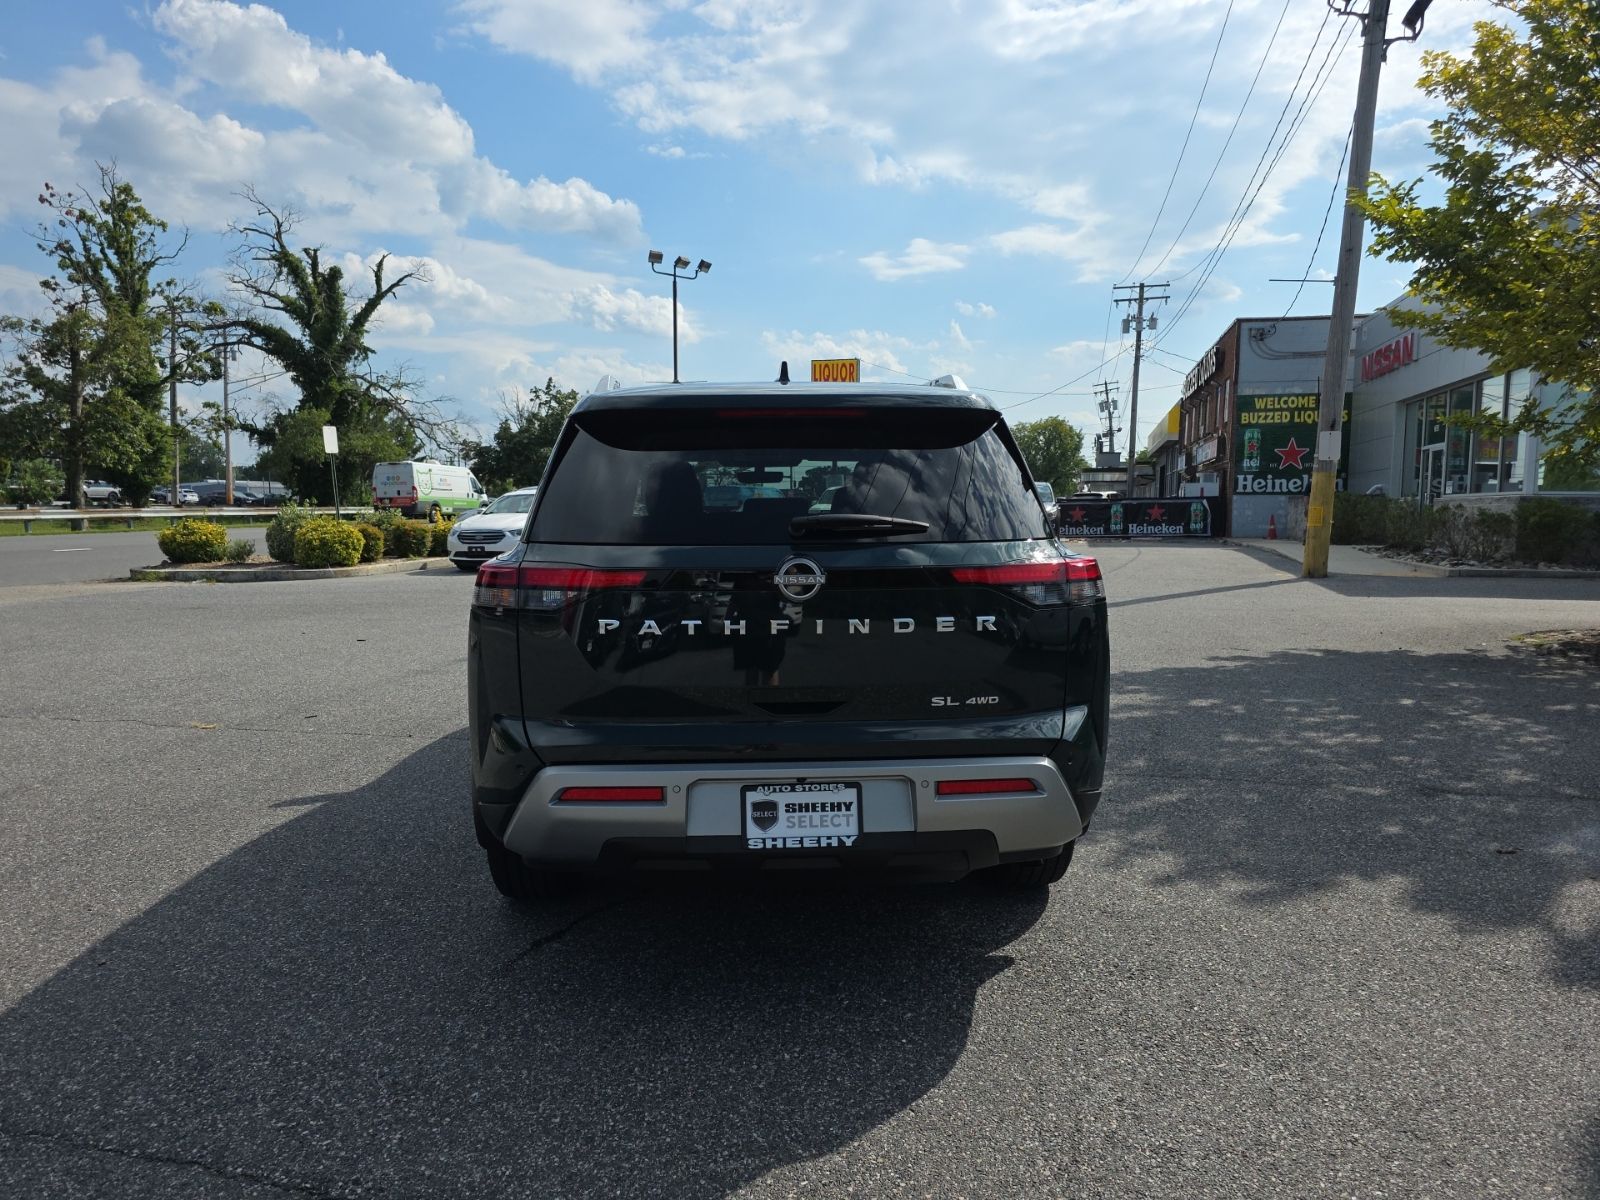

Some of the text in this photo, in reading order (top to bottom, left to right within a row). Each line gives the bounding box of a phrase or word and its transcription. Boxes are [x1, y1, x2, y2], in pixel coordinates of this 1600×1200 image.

[1361, 334, 1413, 381] NISSAN
[813, 362, 855, 382] LIQUOR
[1254, 395, 1317, 410] WELCOME
[1241, 411, 1290, 425] BUZZED
[1059, 524, 1104, 535] eineken
[1128, 523, 1184, 534] Heineken
[775, 576, 824, 584] NISSAN
[598, 615, 998, 636] PATHFINDER
[931, 696, 999, 707] SL 4WD
[756, 783, 845, 793] AUTO STORES
[785, 801, 854, 813] SHEEHY
[786, 814, 854, 829] SELECT
[747, 835, 858, 849] SHEEHY
